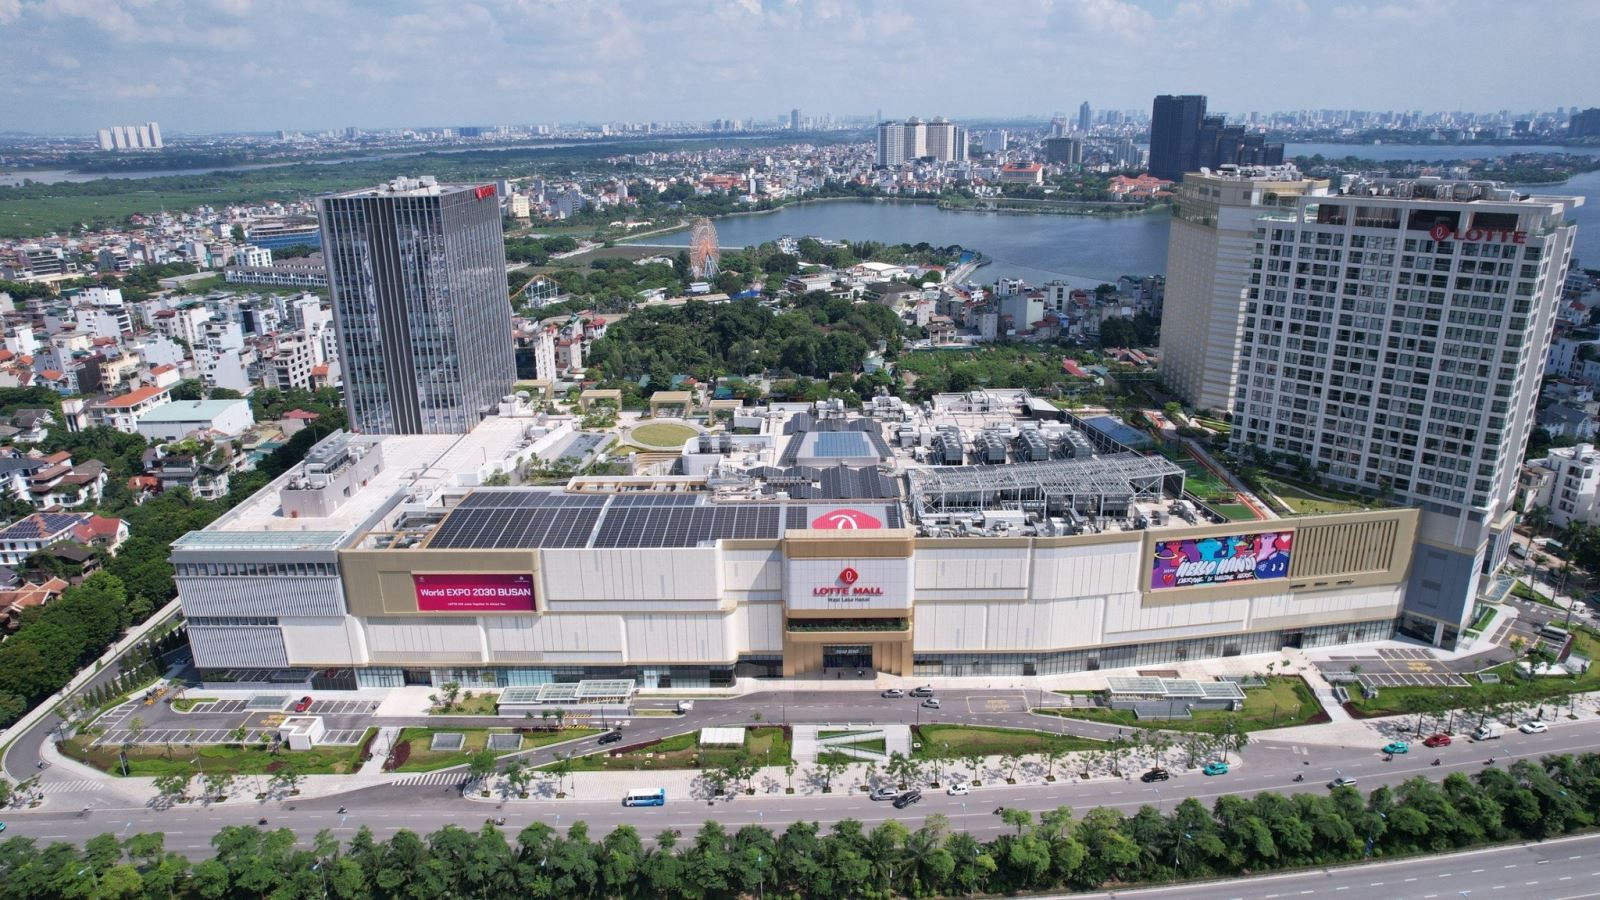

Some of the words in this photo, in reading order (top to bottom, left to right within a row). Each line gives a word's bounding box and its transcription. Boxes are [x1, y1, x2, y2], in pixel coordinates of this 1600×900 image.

[1454, 228, 1527, 243] LOTTE
[1176, 560, 1217, 577] HELLO
[498, 588, 531, 596] BUSAN
[813, 587, 849, 595] LOTTE
[853, 587, 883, 595] MALL
